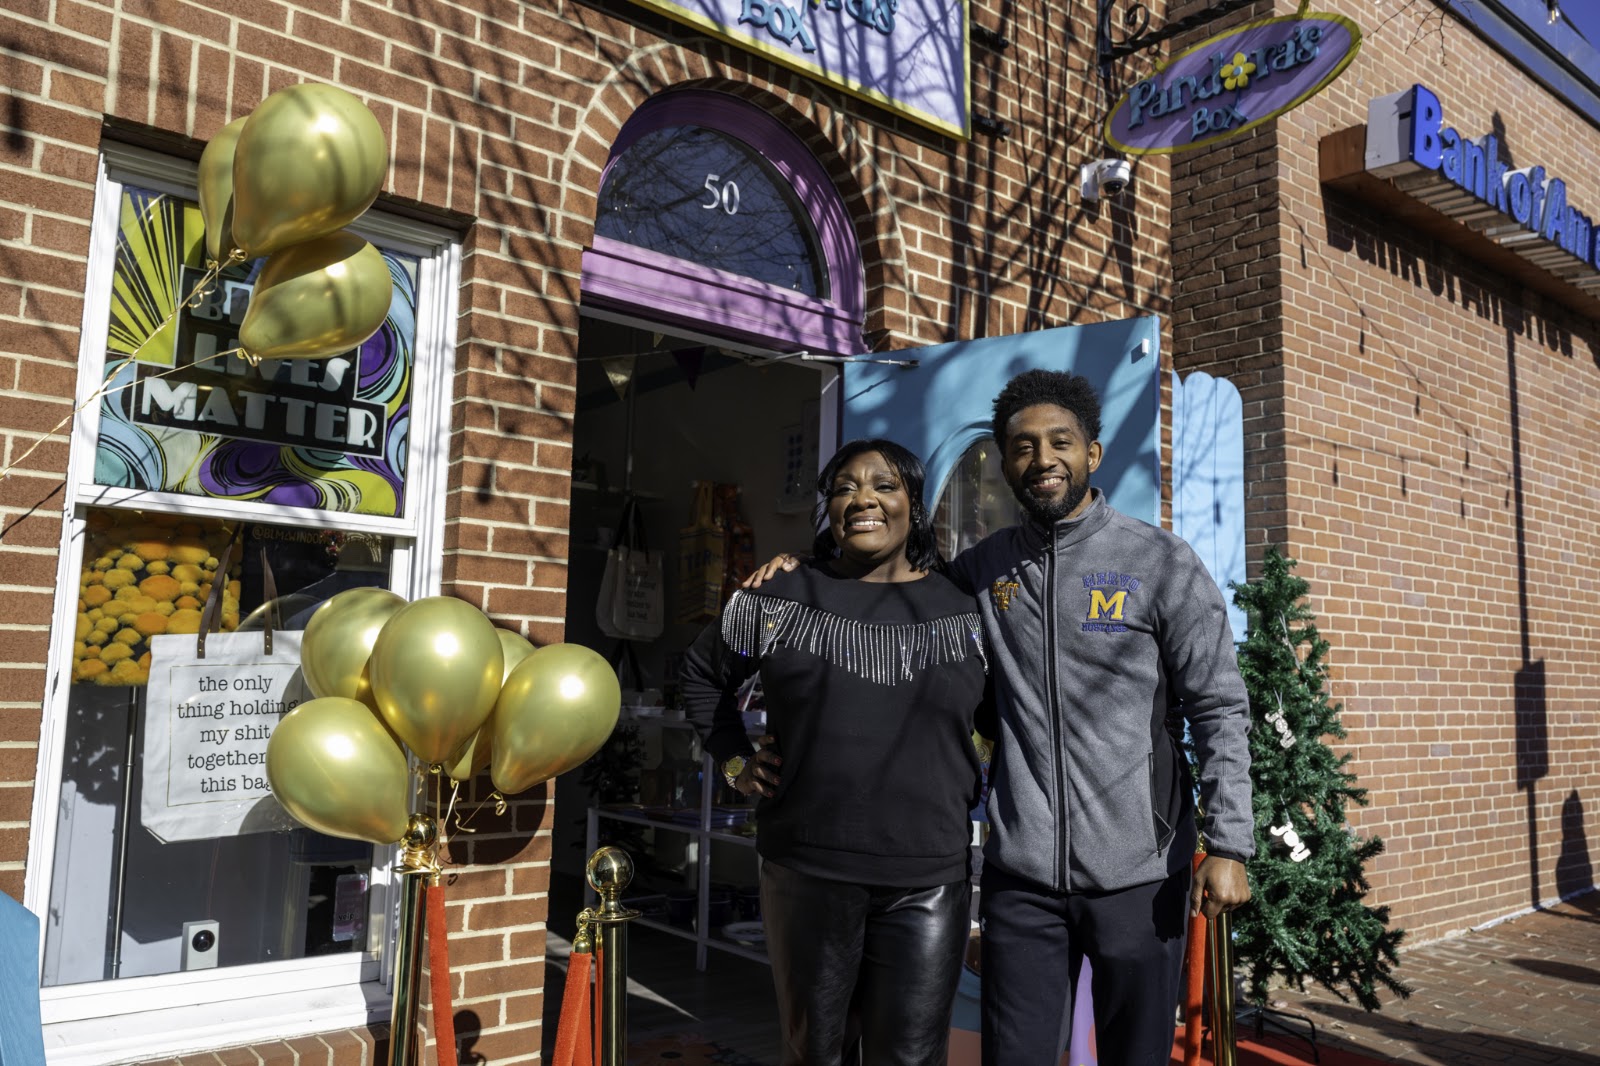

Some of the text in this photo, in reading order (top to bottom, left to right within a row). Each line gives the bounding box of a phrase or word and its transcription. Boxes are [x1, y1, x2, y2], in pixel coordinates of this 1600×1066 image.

[1409, 84, 1509, 213] Bank
[702, 173, 740, 215] 50
[141, 376, 378, 449] MATTER
[1082, 571, 1140, 592] MERVO
[1086, 587, 1129, 622] M
[198, 675, 274, 694] the only
[177, 699, 299, 719] thing holding
[200, 724, 271, 745] my shit
[201, 777, 237, 793] this
